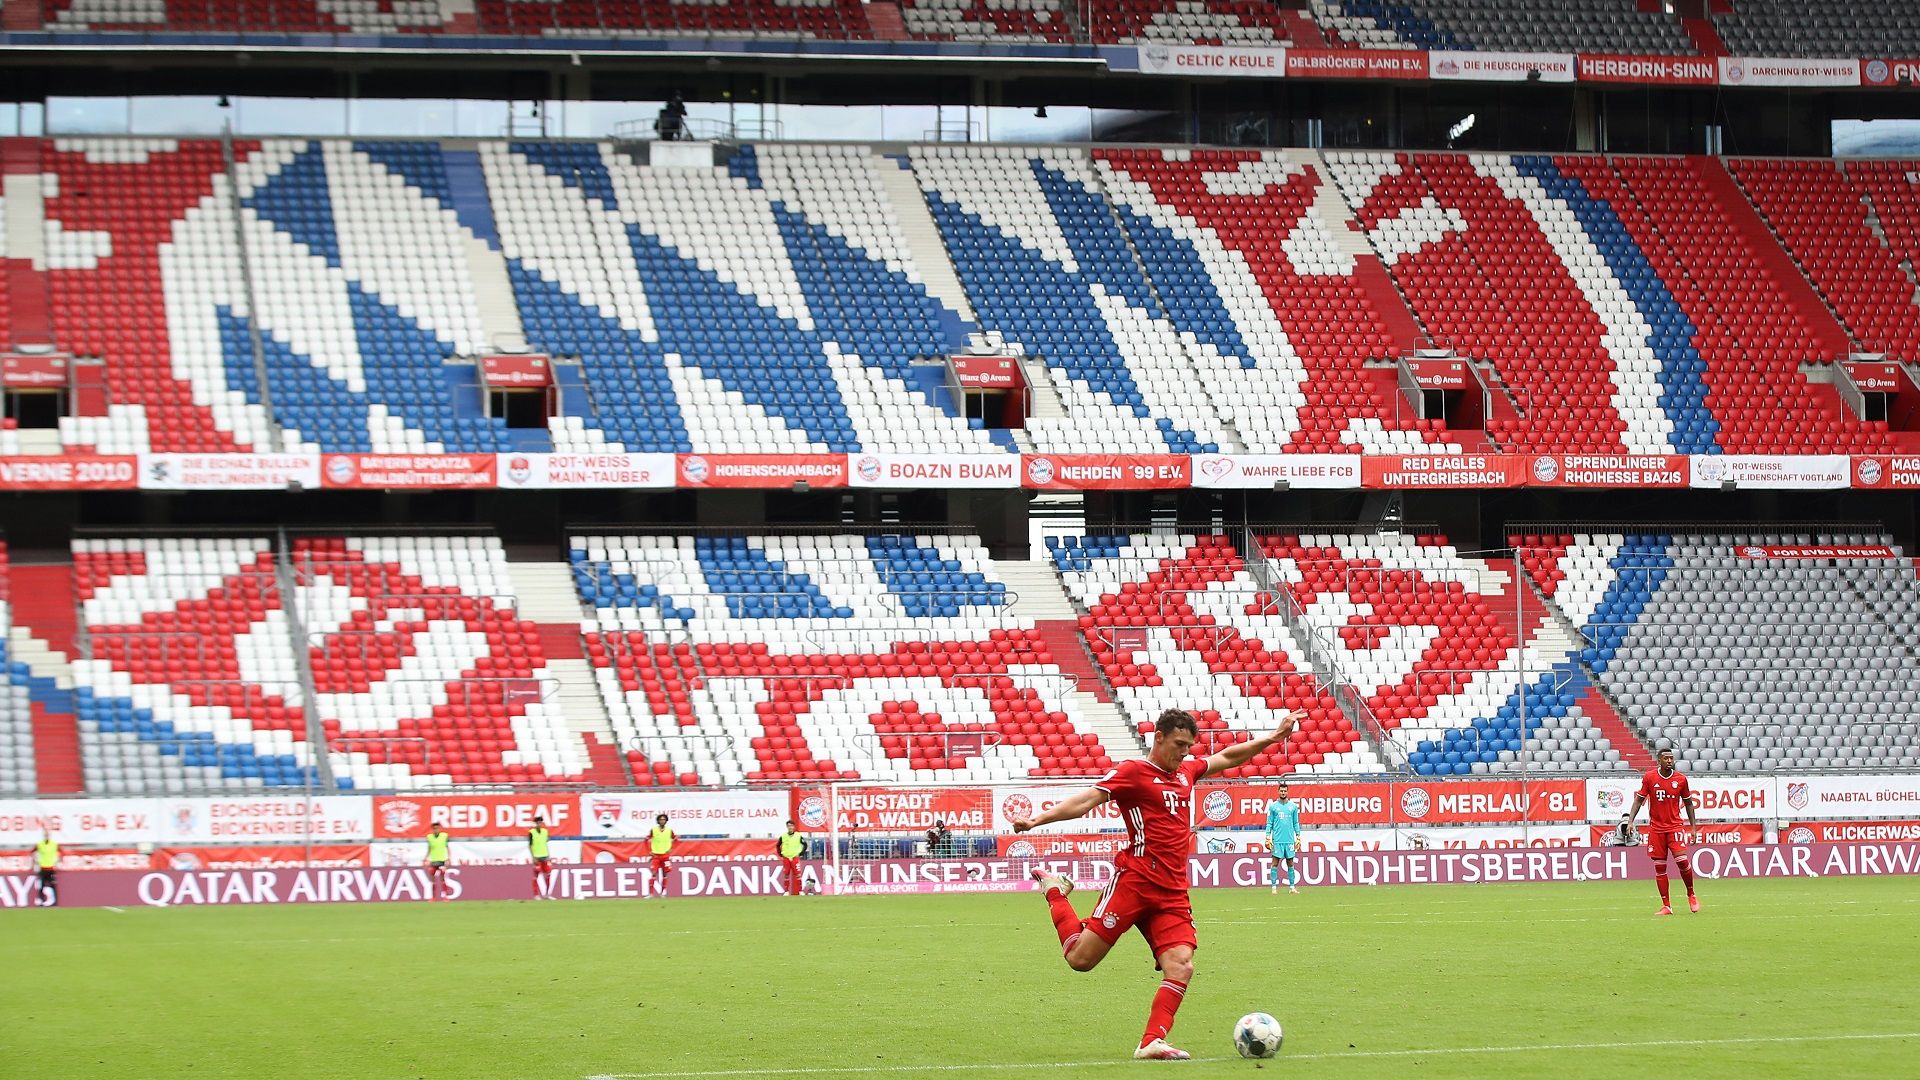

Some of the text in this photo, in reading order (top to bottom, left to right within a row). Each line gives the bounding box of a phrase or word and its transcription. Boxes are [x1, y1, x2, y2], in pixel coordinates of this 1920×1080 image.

[1176, 53, 1275, 68] CELTIC KEULE
[1288, 55, 1422, 70] DELBRÜCKER LAND E.V.
[1463, 60, 1567, 73] DIE HEUSCHRECKEN
[1582, 60, 1713, 78] HERBORN-SINN
[1751, 67, 1853, 77] DARCHING ROT-WEISS
[1442, 376, 1463, 384] Arena
[548, 456, 630, 468] ROT-WEISS
[1402, 457, 1486, 470] RED EAGLES
[1564, 456, 1666, 469] SPRENDLINGER
[1732, 462, 1783, 470] ROT-WEISSE
[1891, 458, 1920, 471] MAG
[75, 462, 133, 481] 2010
[715, 463, 842, 477] HOHENSCHAMBACH
[889, 463, 951, 478] BOAZN
[959, 463, 1013, 478] BUAM
[1060, 466, 1122, 480] NEHDEN
[1158, 465, 1184, 479] E.V.
[1241, 466, 1353, 477] WAHRE LIEBE FCB
[548, 471, 650, 483] MAIN-TAUBER
[1383, 472, 1505, 485] UNTERGRIESBACH
[1565, 471, 1682, 484] RHOIHESSE BAZIS
[1800, 473, 1843, 481] VOGTLAND
[1892, 472, 1920, 485] POW
[1772, 549, 1800, 557] FOR
[837, 793, 933, 811] NEUSTADT
[1438, 793, 1531, 814] MERLAU
[1820, 792, 1872, 803] NAABTAL
[211, 802, 324, 817] EICHSFELDA
[431, 804, 489, 829] RED
[495, 803, 570, 828] DEAF
[631, 807, 779, 820] ROT-WEISSE ADLER LANA
[116, 814, 149, 831] E.V.
[837, 810, 984, 829] A.D. WALDNAAB
[210, 820, 361, 836] BICKENRIEDE E.V.
[1823, 825, 1920, 841] KLICKERWAS
[1705, 831, 1742, 844] KINGS
[1692, 846, 1816, 878] QATAR
[537, 866, 668, 898] VIELEN
[678, 864, 785, 896] DANK
[1231, 848, 1628, 887] GESUNDHEITSBEREICH
[137, 867, 463, 907] QATAR AIRWAYS
[890, 883, 919, 893] SPORT
[943, 881, 1018, 892] MAGENTA SPORT
